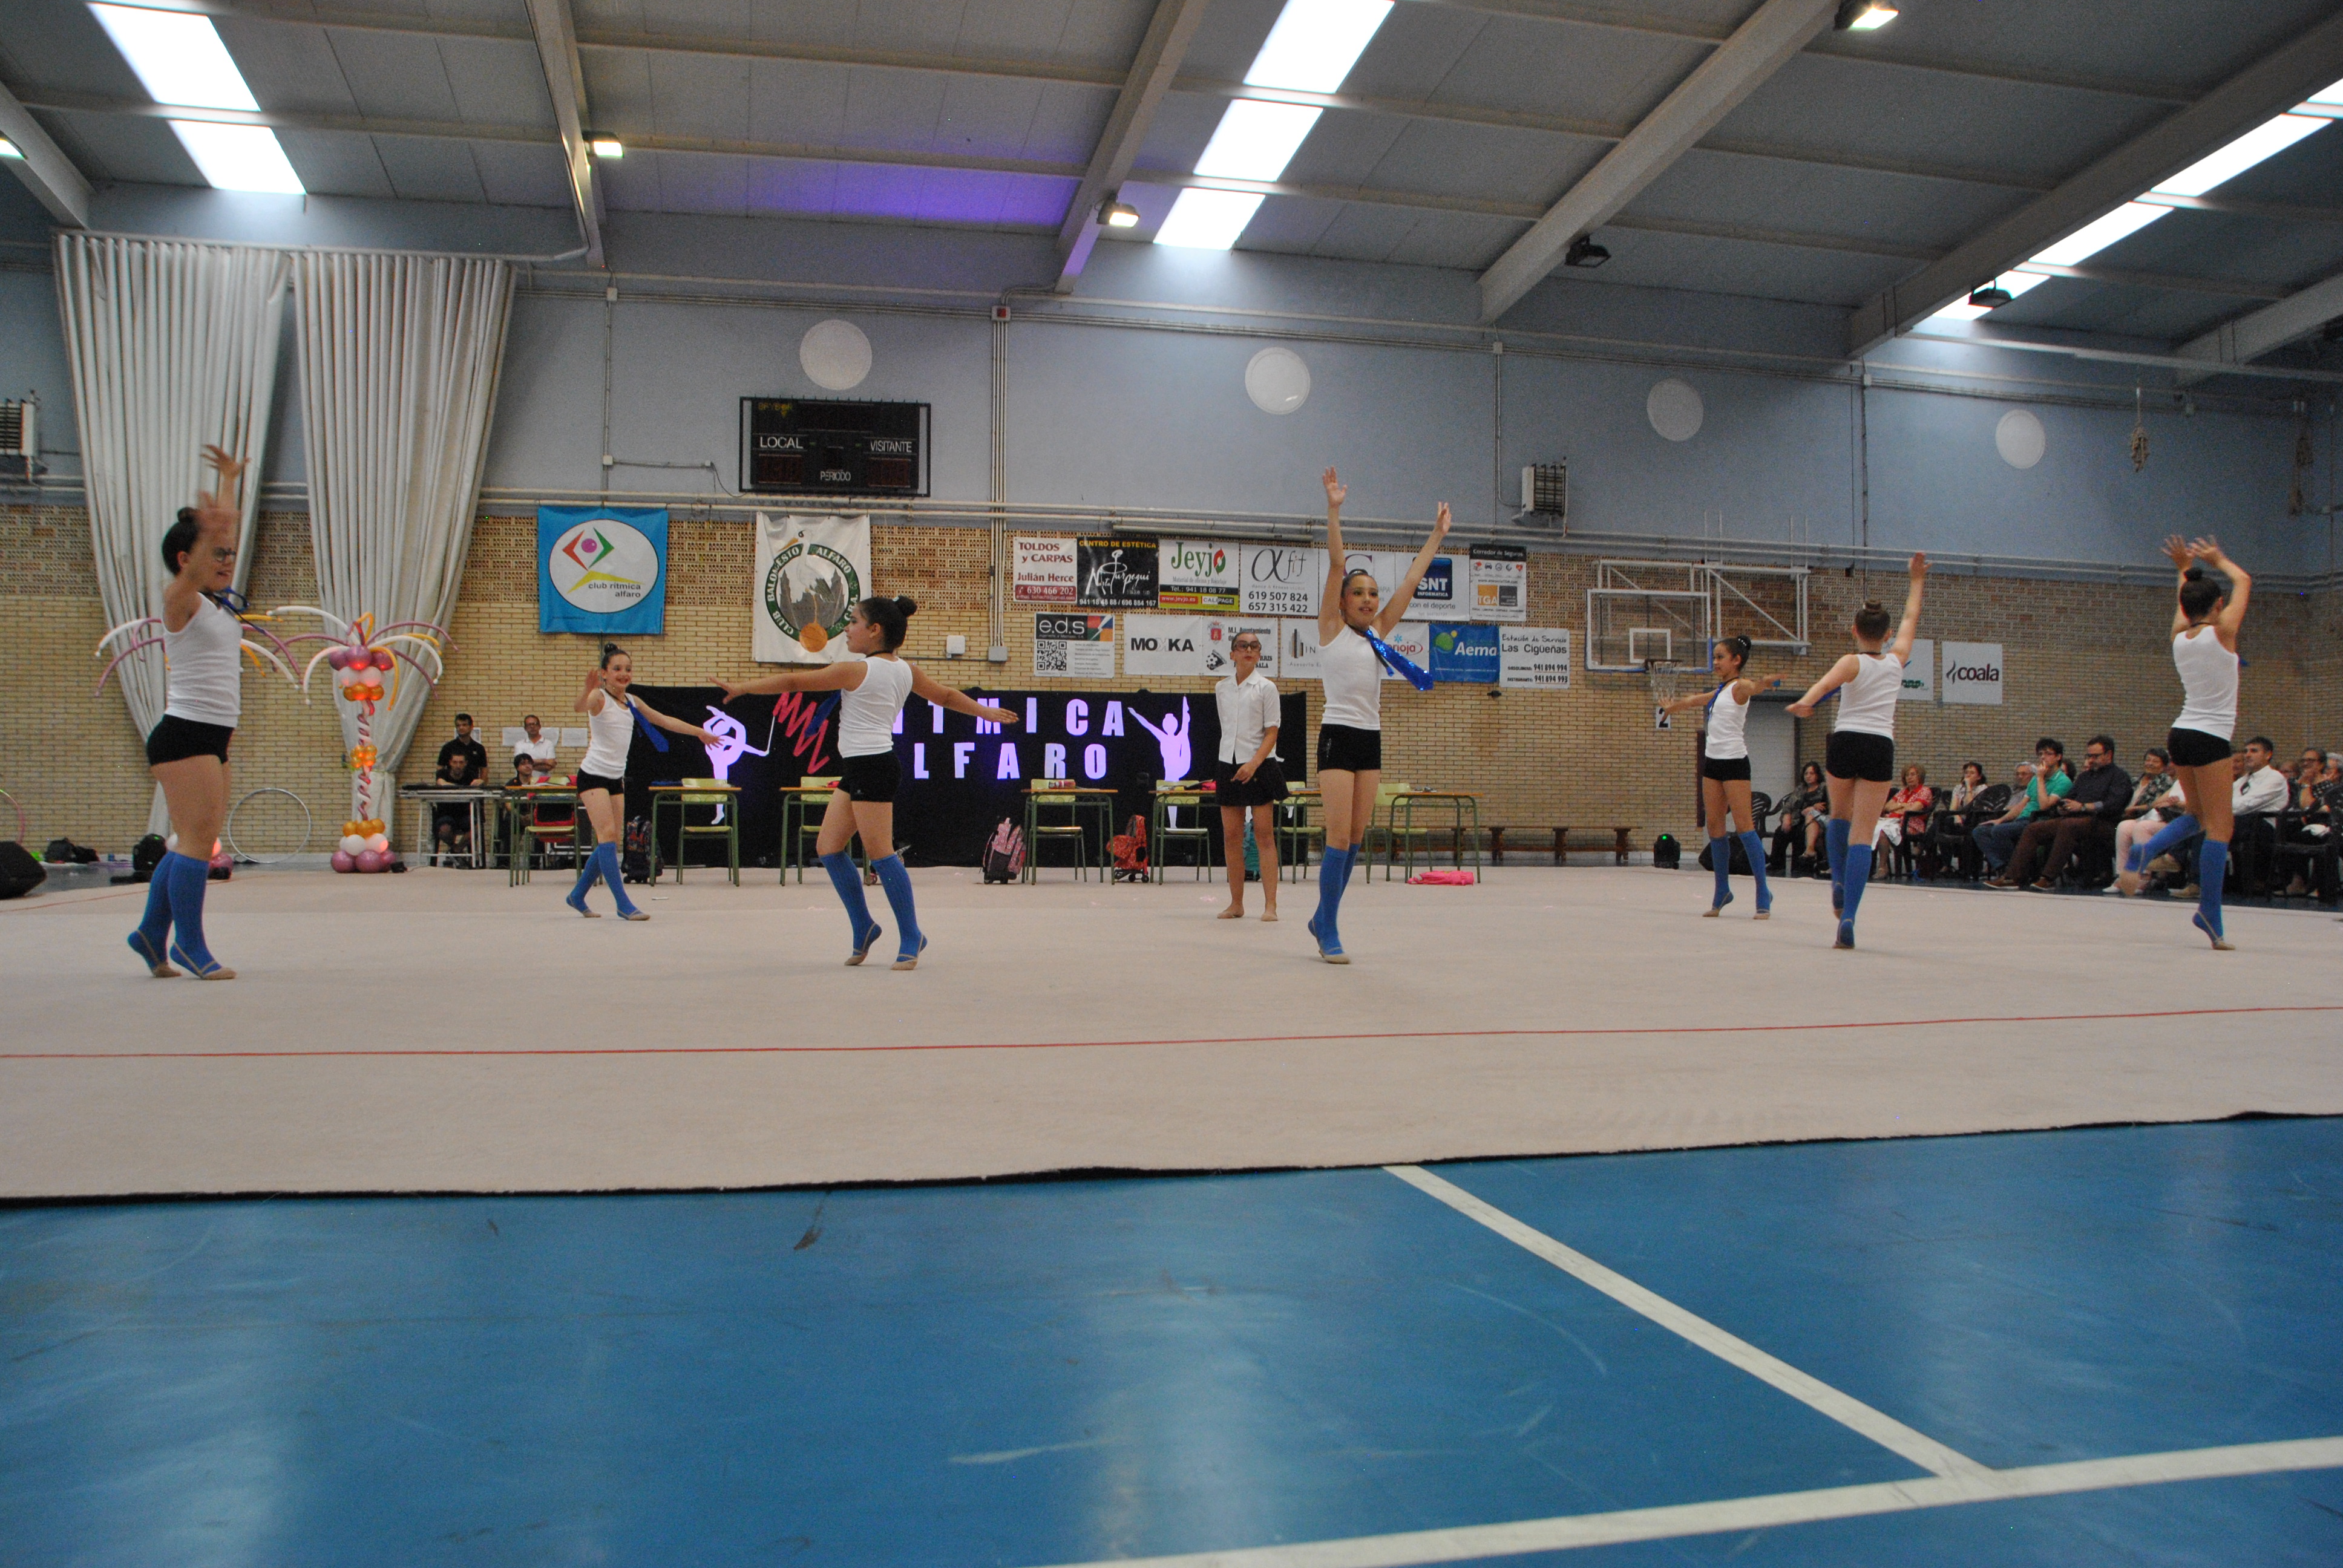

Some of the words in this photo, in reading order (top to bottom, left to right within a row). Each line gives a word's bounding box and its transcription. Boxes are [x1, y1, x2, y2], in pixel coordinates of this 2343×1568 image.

[760, 436, 804, 449] LOCAL
[870, 440, 912, 452] VISITANTE
[820, 471, 851, 482] PERIODO
[1018, 542, 1060, 551] TOLDOS
[1031, 554, 1073, 563] CARPAS
[1171, 541, 1226, 577] Jeyjo
[1017, 572, 1044, 581] Julián
[1048, 573, 1074, 582] Herce
[1418, 577, 1447, 591] SNT
[773, 610, 794, 635] CLUB
[817, 547, 851, 573] ALFARO
[1027, 586, 1041, 594] 630
[1043, 586, 1057, 595] 466
[1060, 587, 1073, 595] 202
[1248, 591, 1267, 599] 619
[1270, 592, 1287, 601] 507
[1289, 593, 1308, 602] 824
[1478, 595, 1498, 604] TGA
[1248, 602, 1267, 611] 657
[1270, 603, 1287, 612] 315
[1289, 604, 1308, 613] 422
[1431, 601, 1455, 610] deporte
[1039, 617, 1085, 634] e.d.s
[1455, 642, 1497, 656] Aema
[1501, 644, 1519, 653] Las
[1524, 644, 1567, 655] Cigüeñas
[1958, 664, 1999, 681] coala
[1659, 707, 1669, 728] 2
